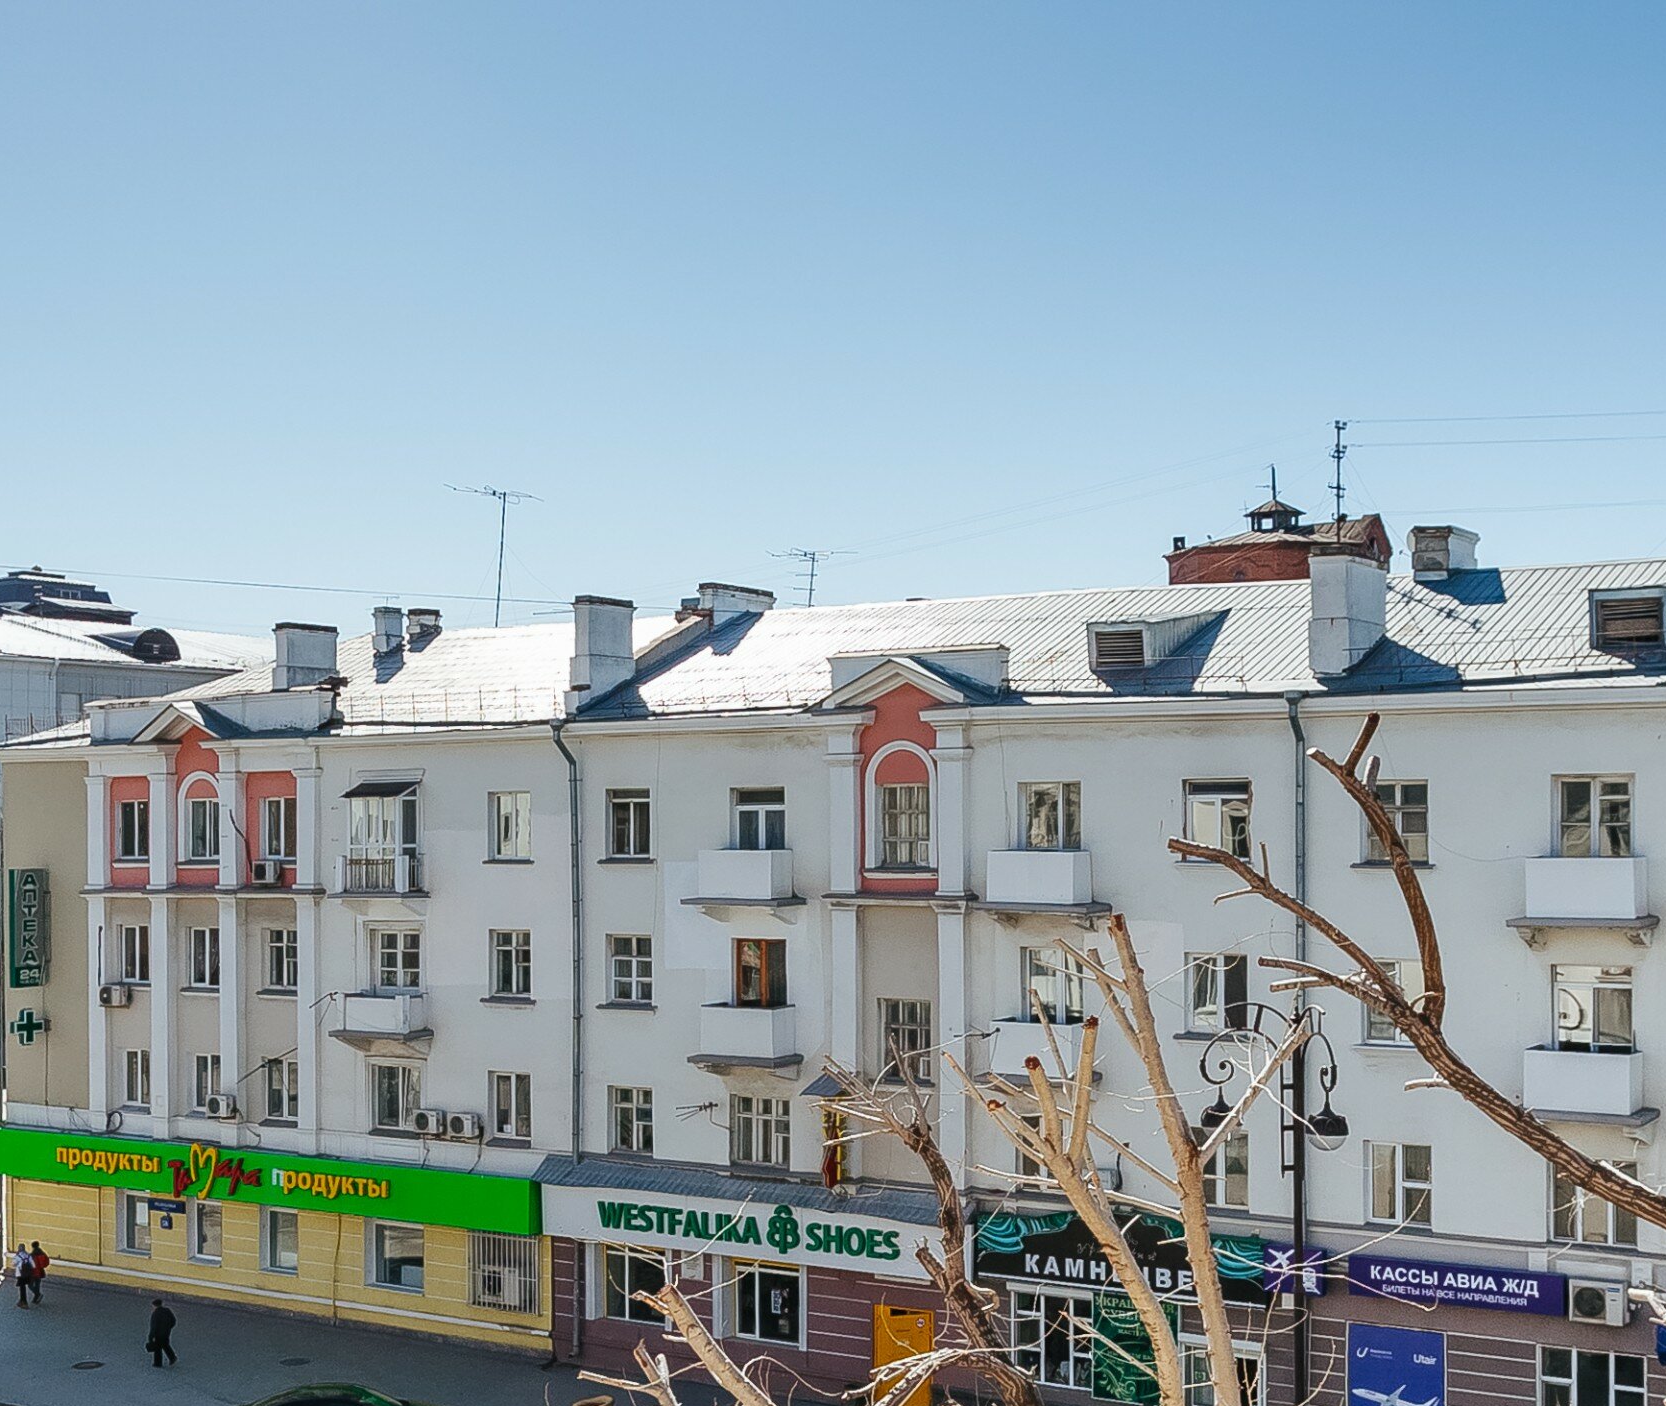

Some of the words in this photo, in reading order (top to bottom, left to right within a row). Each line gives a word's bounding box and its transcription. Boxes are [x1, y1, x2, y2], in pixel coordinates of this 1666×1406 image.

[21, 872, 39, 967] АПТЕКА
[20, 969, 40, 980] 24
[56, 1146, 160, 1174] продукты
[272, 1167, 389, 1199] продукты
[597, 1201, 762, 1245] WESTFALIKA
[806, 1223, 901, 1261] SHOES
[1370, 1265, 1438, 1285] КАССЫ
[1443, 1272, 1497, 1292] АВИА
[1502, 1277, 1540, 1298] Ж/Д
[1383, 1284, 1420, 1296] БИЛЕТЫ
[1421, 1288, 1435, 1297] НА
[1437, 1290, 1455, 1299] ВСЕ
[1457, 1292, 1528, 1307] НАПРАВЛЕНИЯ
[1413, 1353, 1438, 1366] Utair
